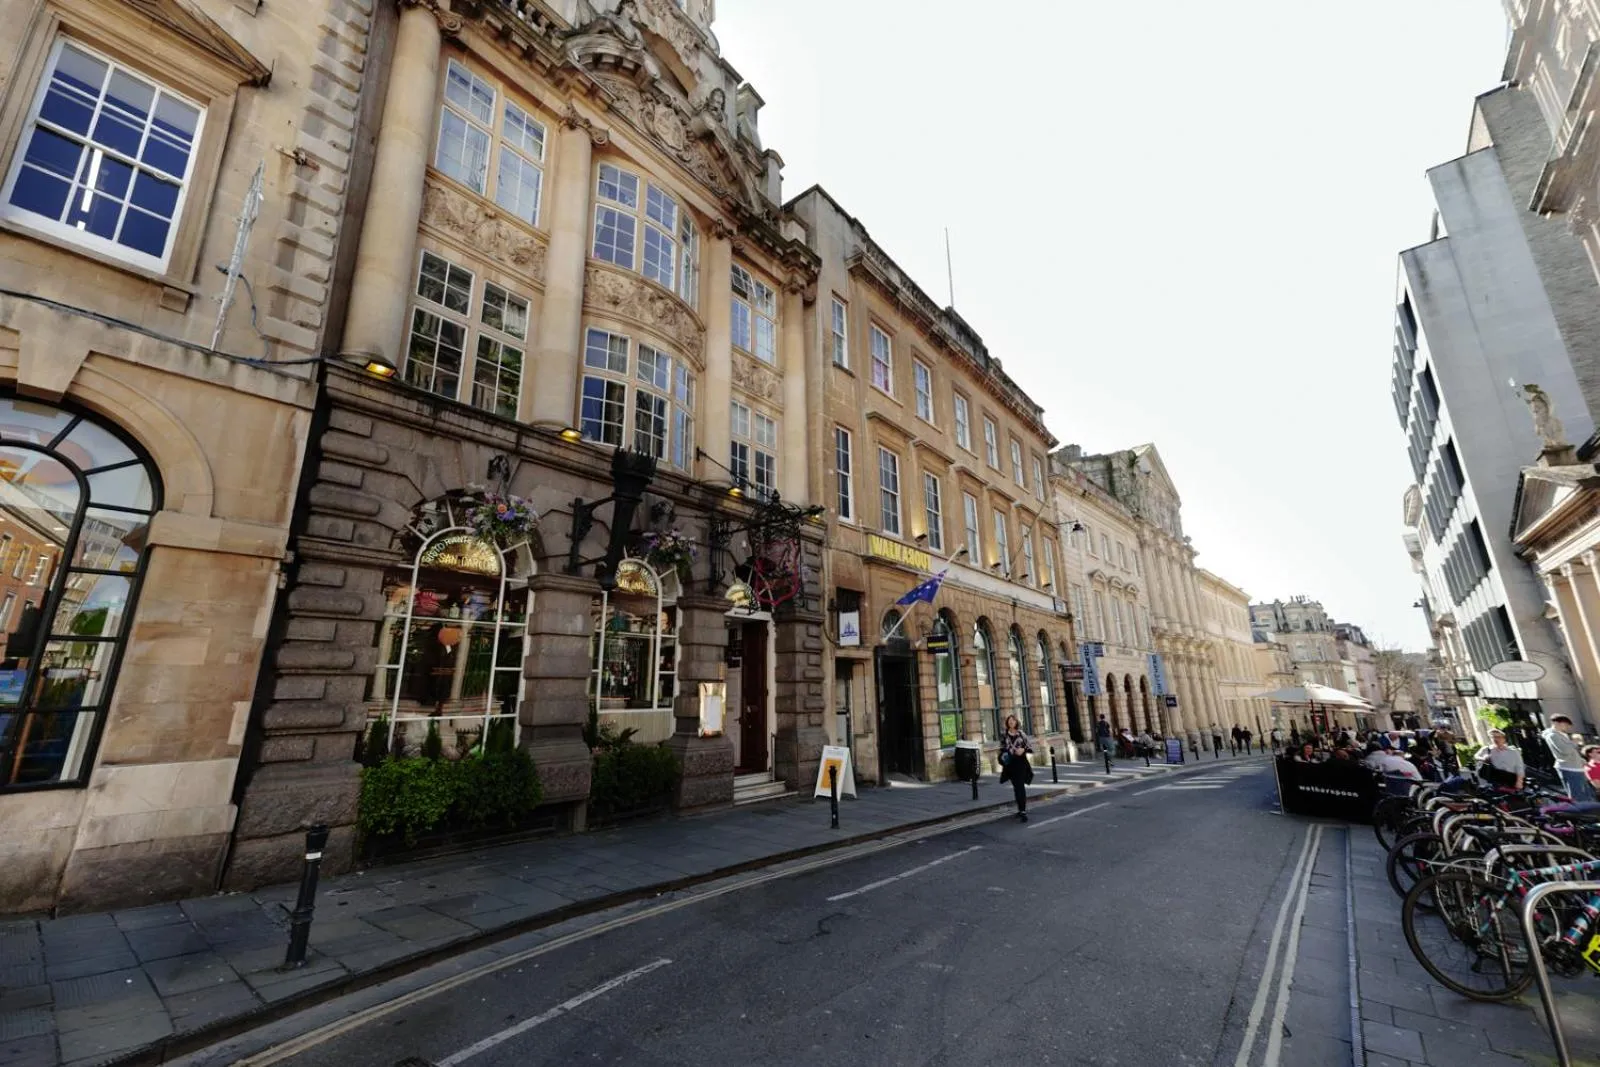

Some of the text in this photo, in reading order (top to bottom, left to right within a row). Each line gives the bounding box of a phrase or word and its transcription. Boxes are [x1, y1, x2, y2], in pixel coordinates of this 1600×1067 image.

[438, 552, 458, 565] SAN
[871, 535, 929, 571] WALKABOUT
[1298, 785, 1359, 798] wetherspoon
